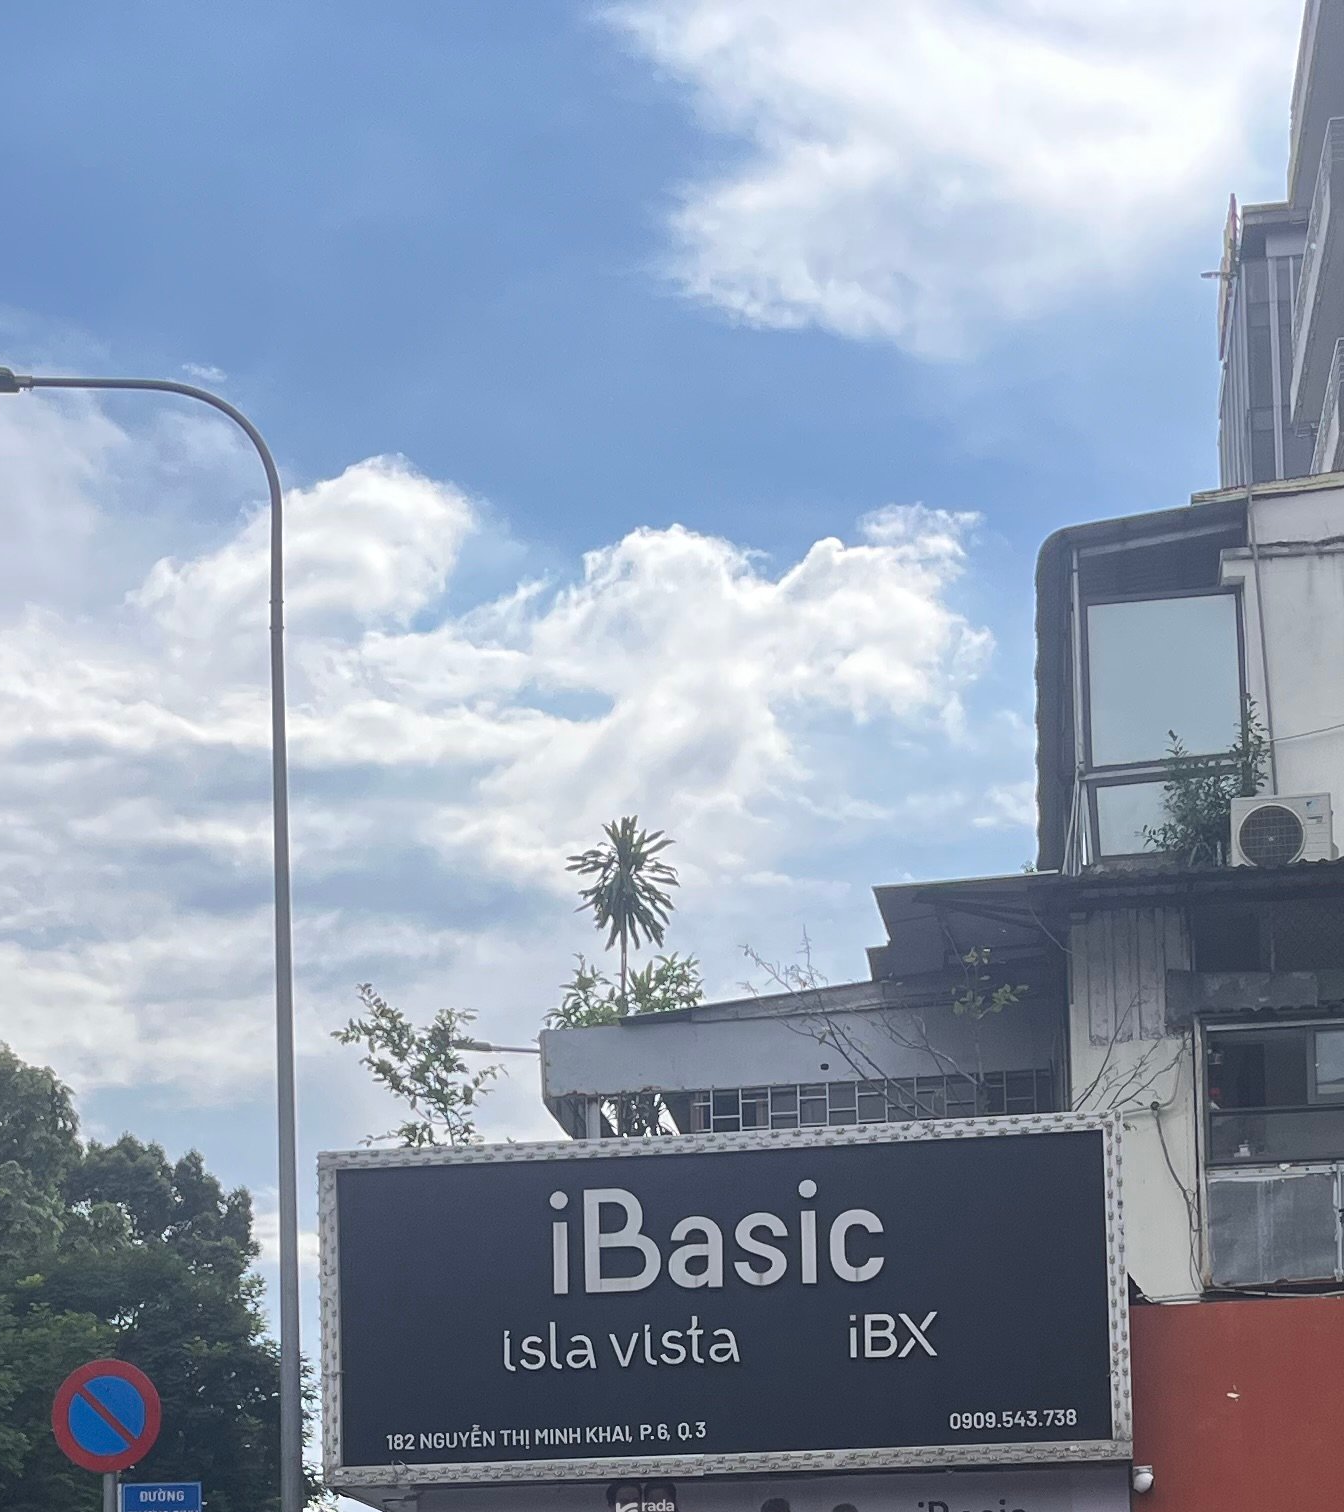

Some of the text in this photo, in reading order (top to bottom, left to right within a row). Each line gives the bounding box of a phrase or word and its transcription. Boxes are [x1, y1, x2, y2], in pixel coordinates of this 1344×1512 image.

[551, 1179, 886, 1295] iBasic
[504, 1315, 740, 1372] isla vista
[850, 1311, 937, 1359] iBX
[387, 1434, 415, 1450] 182
[420, 1424, 495, 1449] NGUYỄN
[500, 1430, 530, 1450] THỊ
[535, 1428, 580, 1446] MINH
[586, 1425, 633, 1444] KHAI,
[949, 1409, 1077, 1429] 0909.543.738
[140, 1488, 185, 1502] ĐƯỜNG
